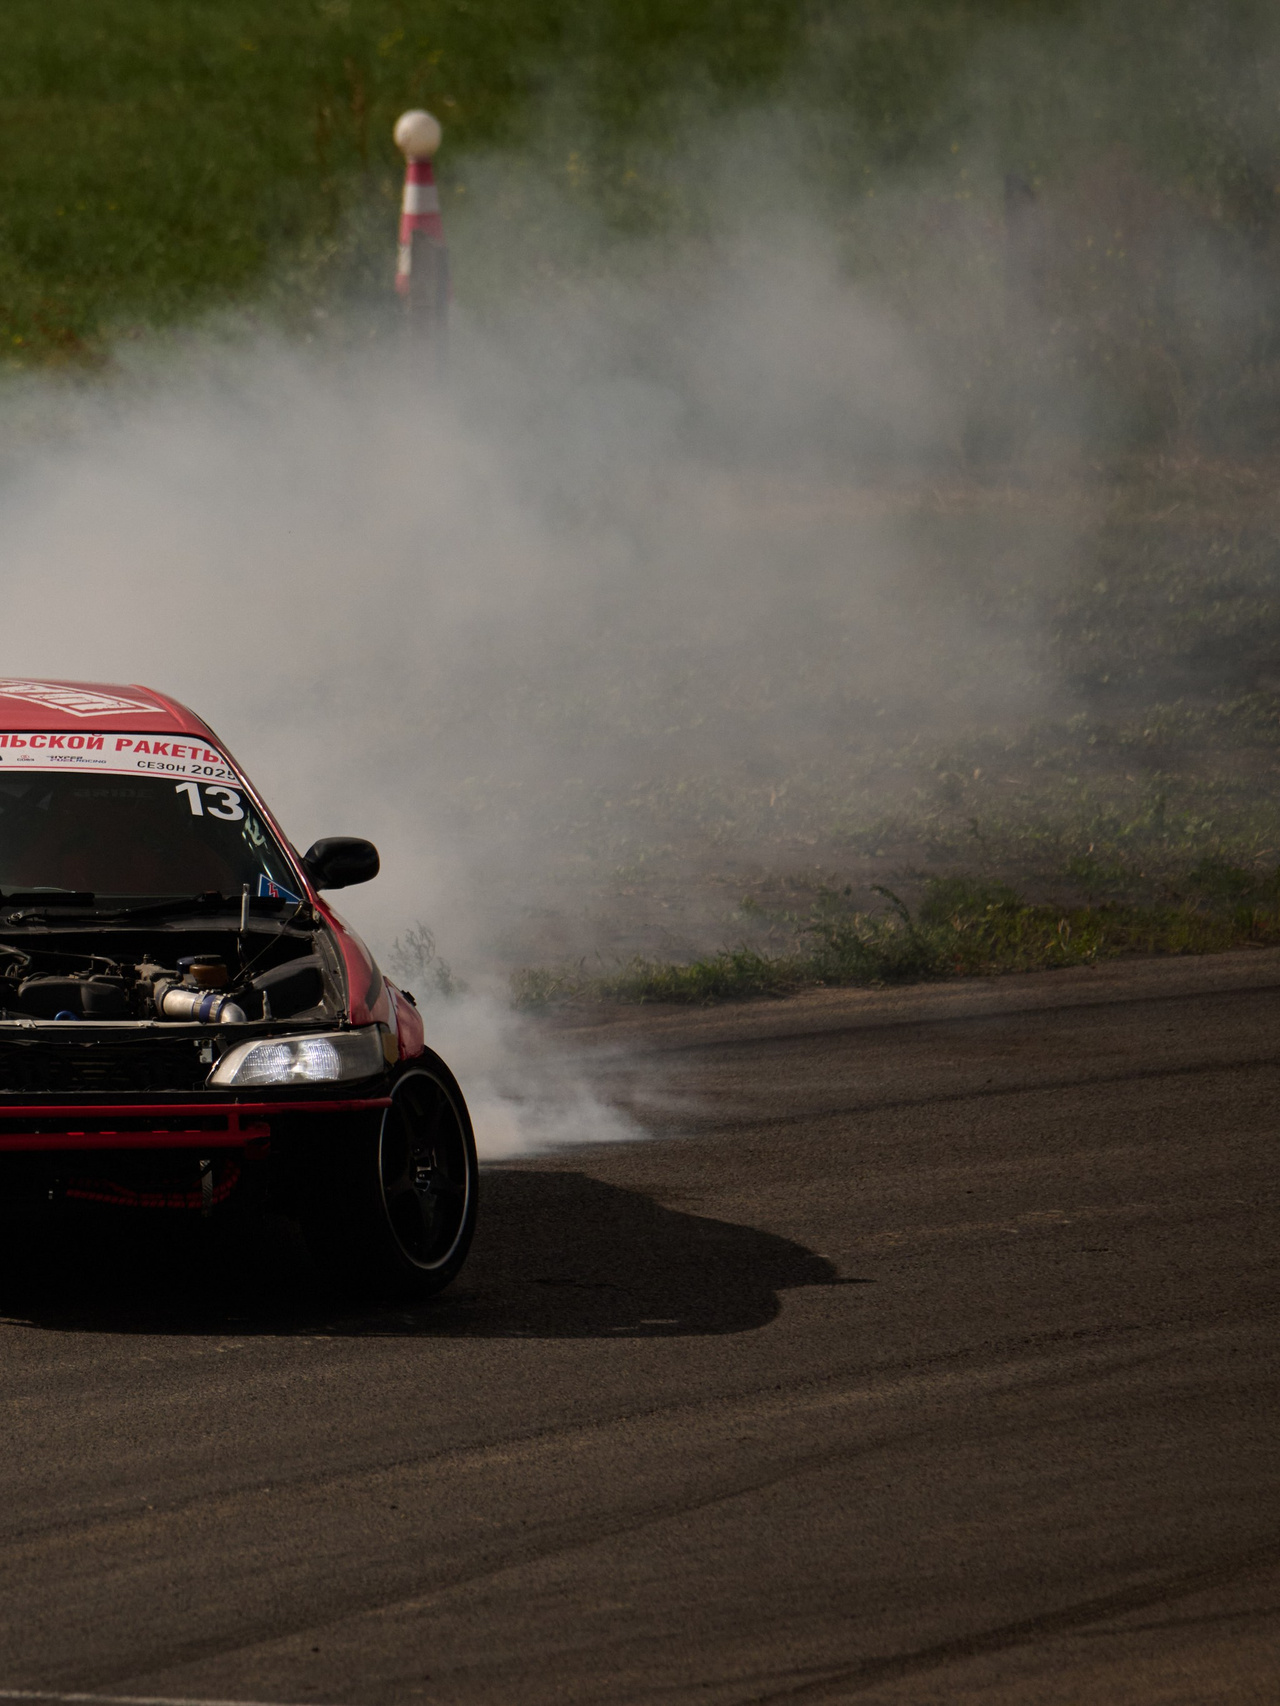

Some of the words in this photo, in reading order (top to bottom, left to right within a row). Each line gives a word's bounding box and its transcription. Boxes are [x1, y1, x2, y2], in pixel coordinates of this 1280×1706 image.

[137, 760, 186, 773] СЕЗОН
[191, 764, 237, 781] 2025
[175, 781, 245, 821] 13
